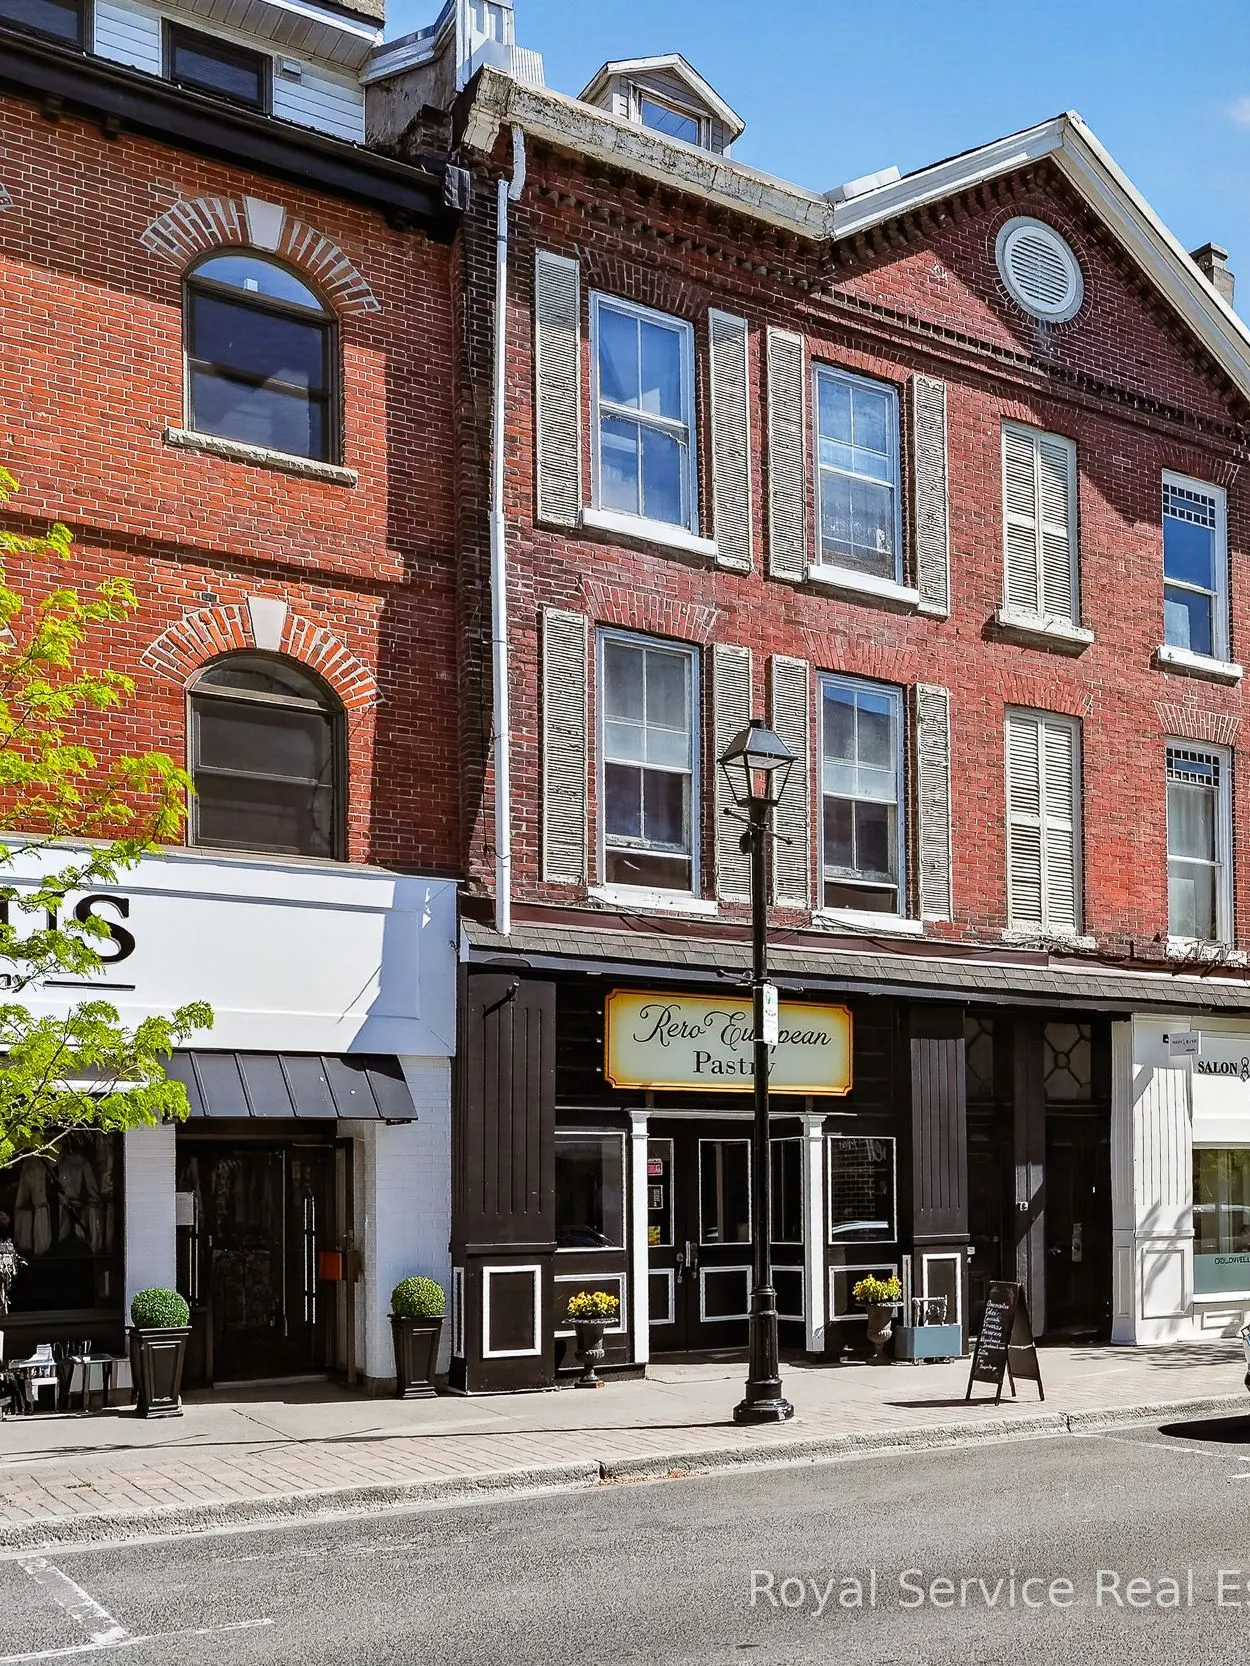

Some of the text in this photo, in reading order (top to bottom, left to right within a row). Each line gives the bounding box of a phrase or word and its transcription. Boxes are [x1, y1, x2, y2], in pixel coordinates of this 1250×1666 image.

[633, 1004, 706, 1047] Rero
[704, 1011, 831, 1054] Eupean
[1198, 1061, 1238, 1075] SALON
